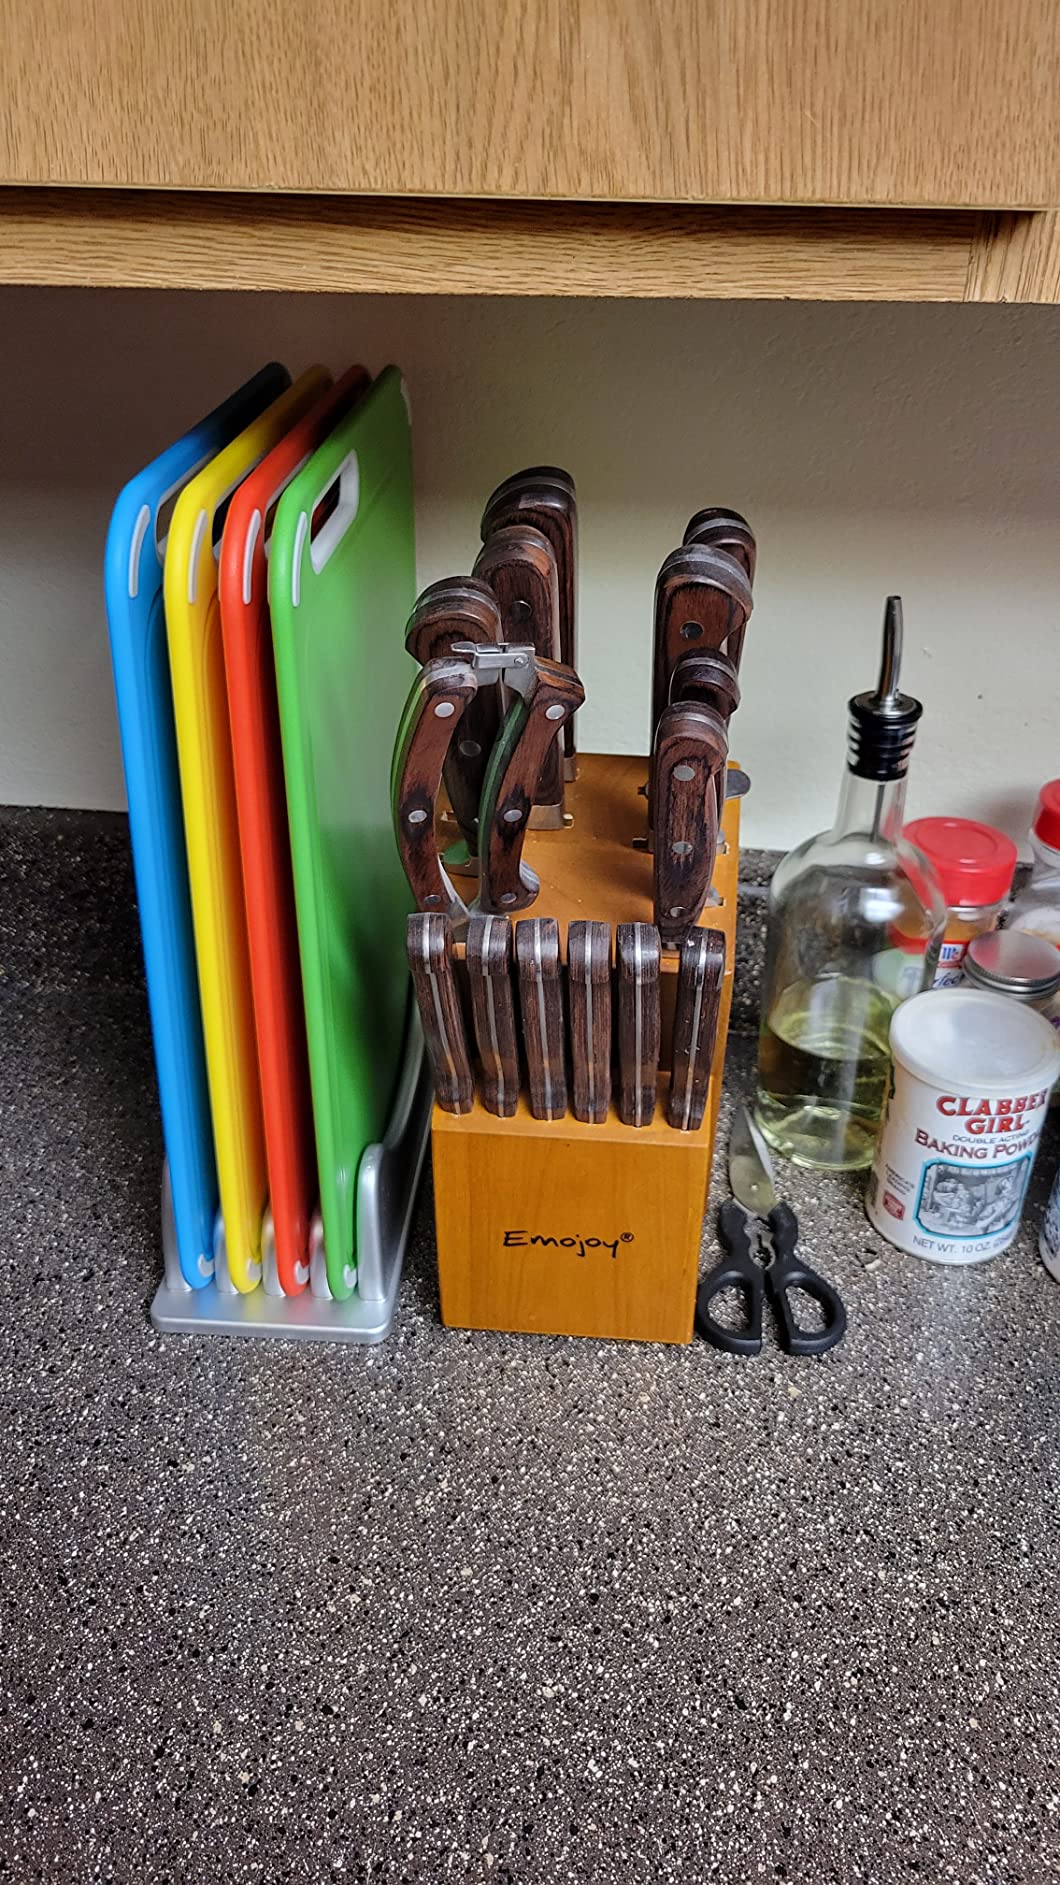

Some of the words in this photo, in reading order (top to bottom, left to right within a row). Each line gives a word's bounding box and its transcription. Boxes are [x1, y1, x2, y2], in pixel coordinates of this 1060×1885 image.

[965, 1114, 1030, 1135] GIRL
[914, 1128, 988, 1159] BAKING
[952, 1134, 997, 1145] DOUBLE
[912, 1235, 936, 1250] NET
[961, 1245, 973, 1254] 10
[975, 1241, 991, 1252] OZ
